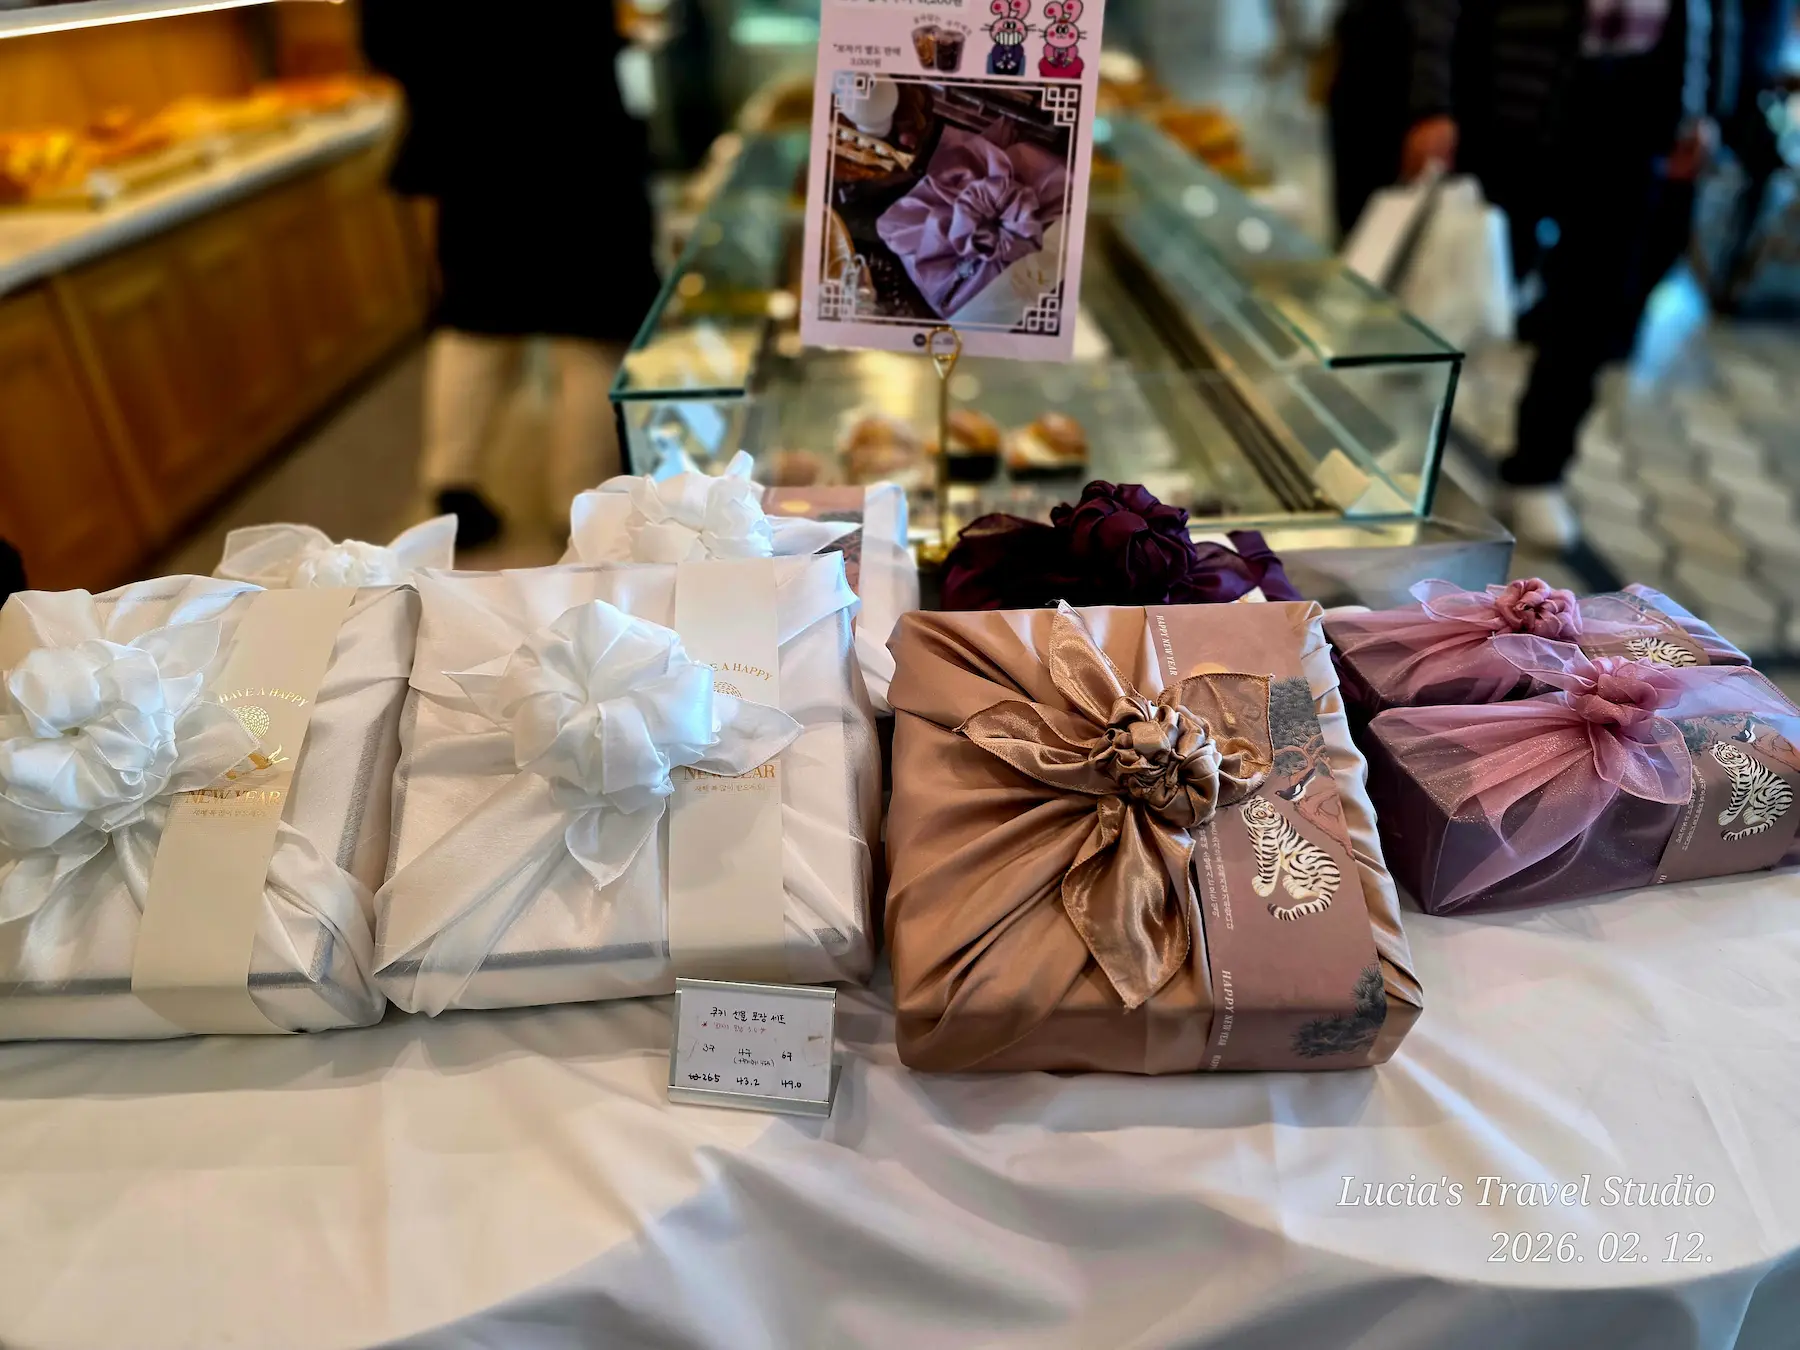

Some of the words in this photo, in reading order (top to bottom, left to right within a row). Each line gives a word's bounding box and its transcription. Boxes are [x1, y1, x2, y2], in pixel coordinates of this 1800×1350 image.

[1156, 615, 1169, 637] HAPPY
[1162, 637, 1173, 656] NEW
[722, 662, 730, 671] A
[733, 662, 774, 681] HAPPY
[1167, 656, 1178, 676] YEAR
[218, 687, 254, 704] HAVE
[257, 688, 265, 696] A
[269, 688, 309, 707] HAPPY
[234, 790, 281, 805] YEAR
[1222, 969, 1235, 1013] HAPPY
[710, 1007, 726, 1018] 쿠키
[733, 1011, 747, 1022] 선물
[752, 1012, 767, 1022] 포장
[771, 1014, 786, 1024] 세트
[1222, 1015, 1235, 1031] NEW
[736, 1077, 760, 1087] 43.2
[781, 1080, 802, 1090] 49.0
